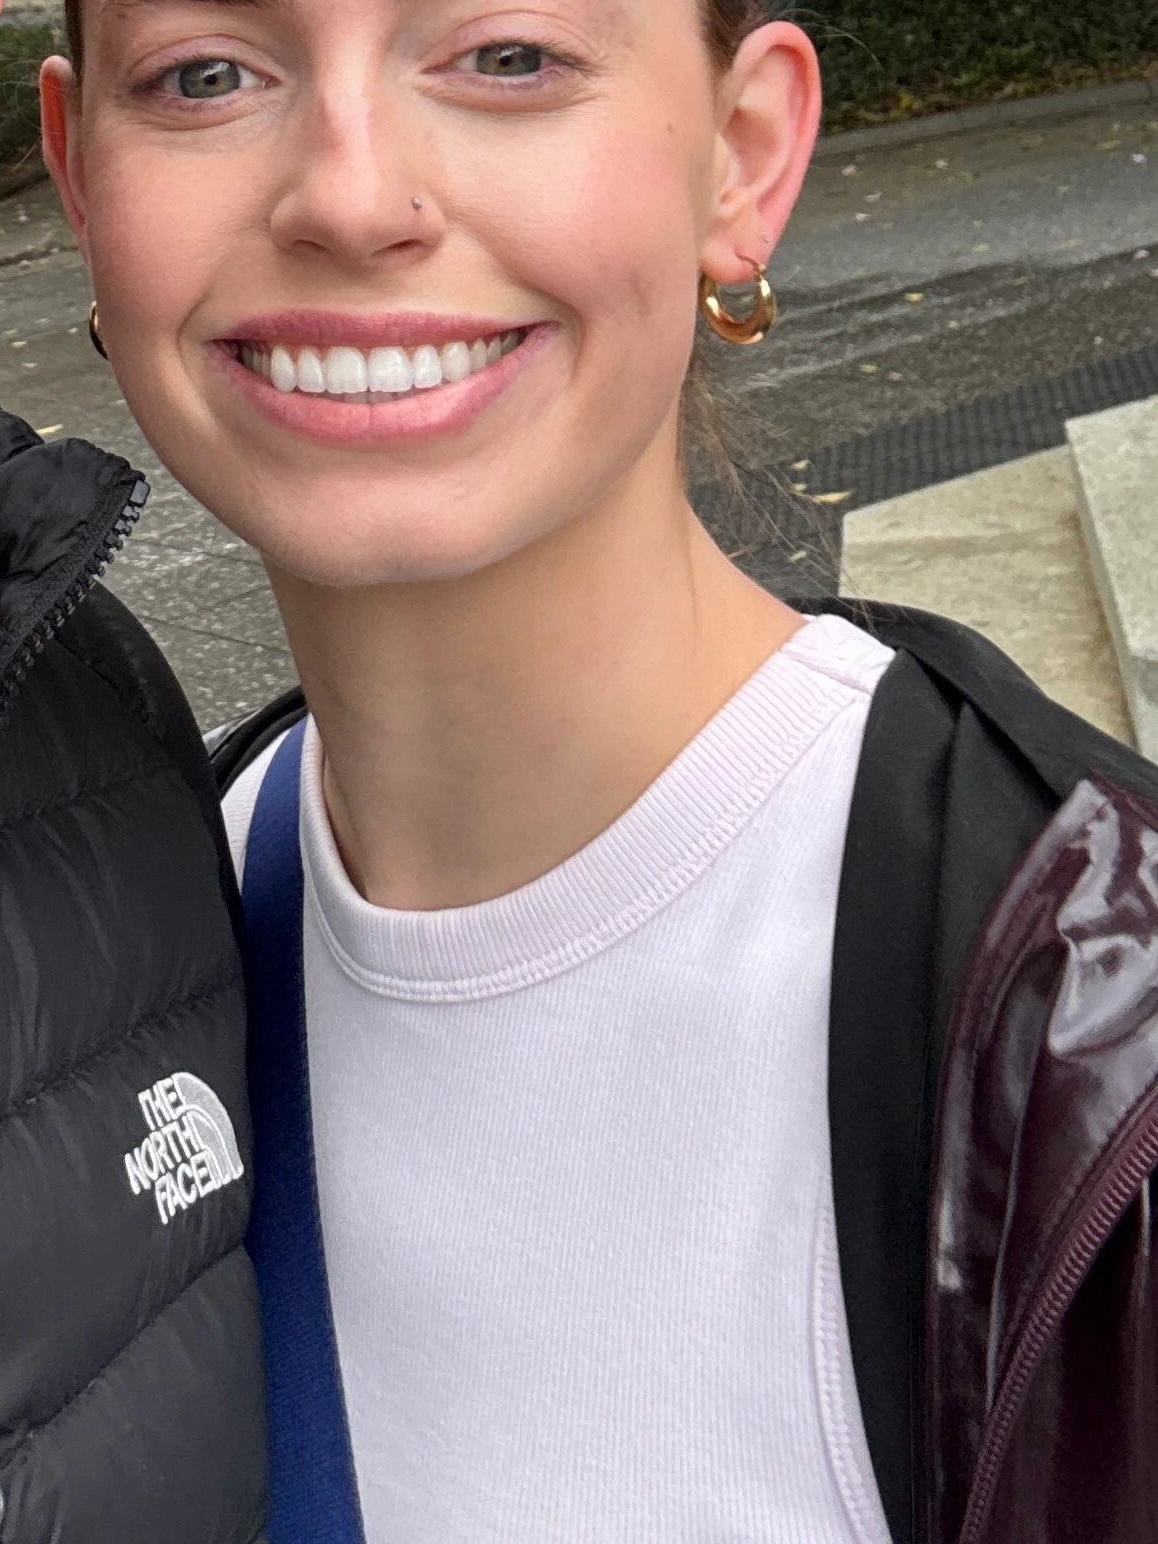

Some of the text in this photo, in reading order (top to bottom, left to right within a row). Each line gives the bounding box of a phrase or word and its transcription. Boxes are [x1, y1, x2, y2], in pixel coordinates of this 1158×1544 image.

[138, 1077, 185, 1131] THE
[124, 1112, 204, 1195] NORTH
[154, 1148, 216, 1224] FACE
